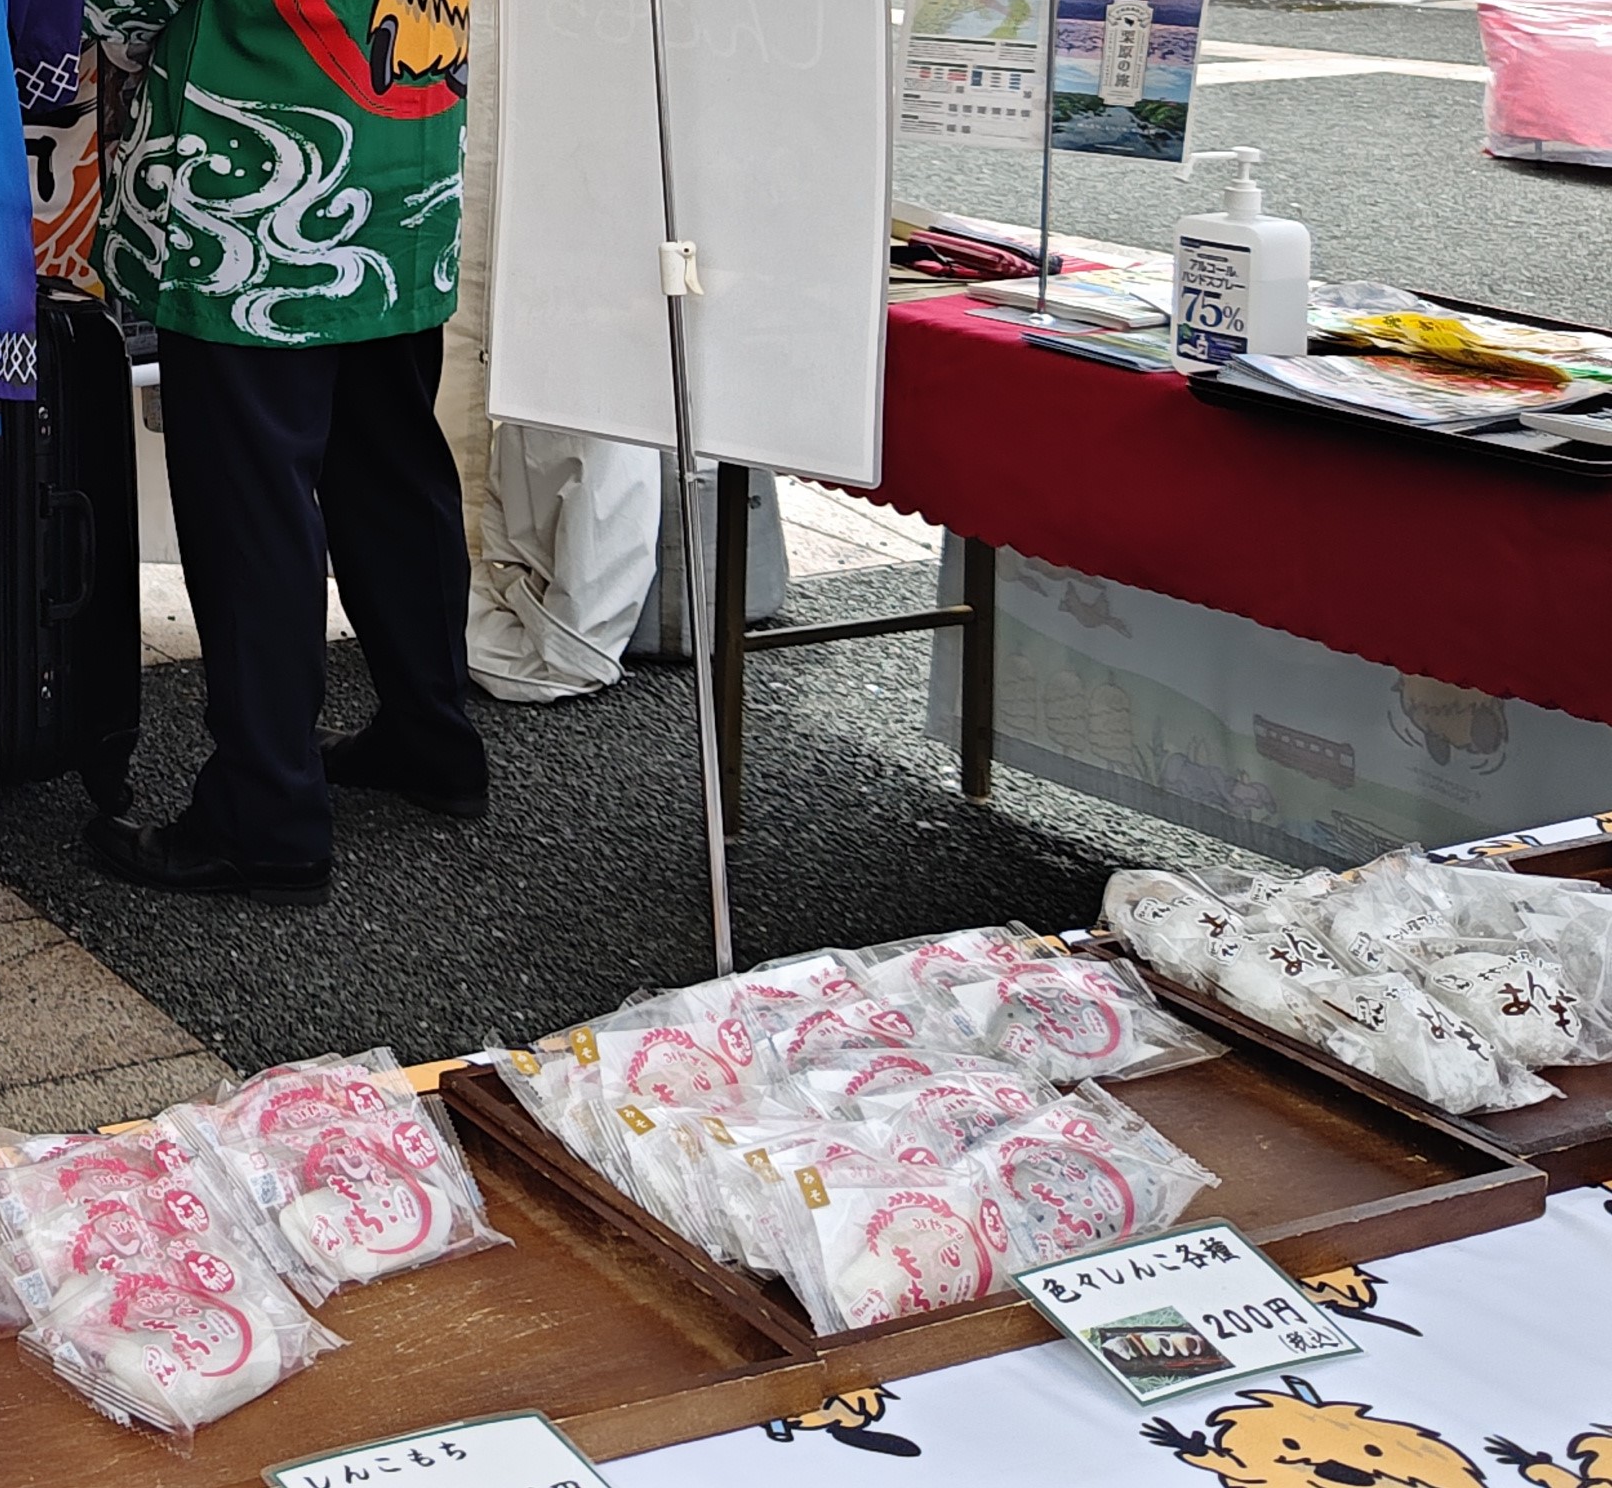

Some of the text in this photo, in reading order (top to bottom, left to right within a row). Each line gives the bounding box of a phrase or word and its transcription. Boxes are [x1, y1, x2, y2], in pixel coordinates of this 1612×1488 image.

[1114, 29, 1136, 88] 栗原の旅
[1182, 271, 1246, 290] ハンドスプレー
[1189, 258, 1236, 277] アルコール
[1181, 285, 1245, 332] 75%
[1042, 1236, 1241, 1304] 色々しんこ各種
[1203, 1297, 1308, 1339] 200円
[1281, 1326, 1344, 1355] (税込)
[303, 1440, 468, 1488] しんこもち
